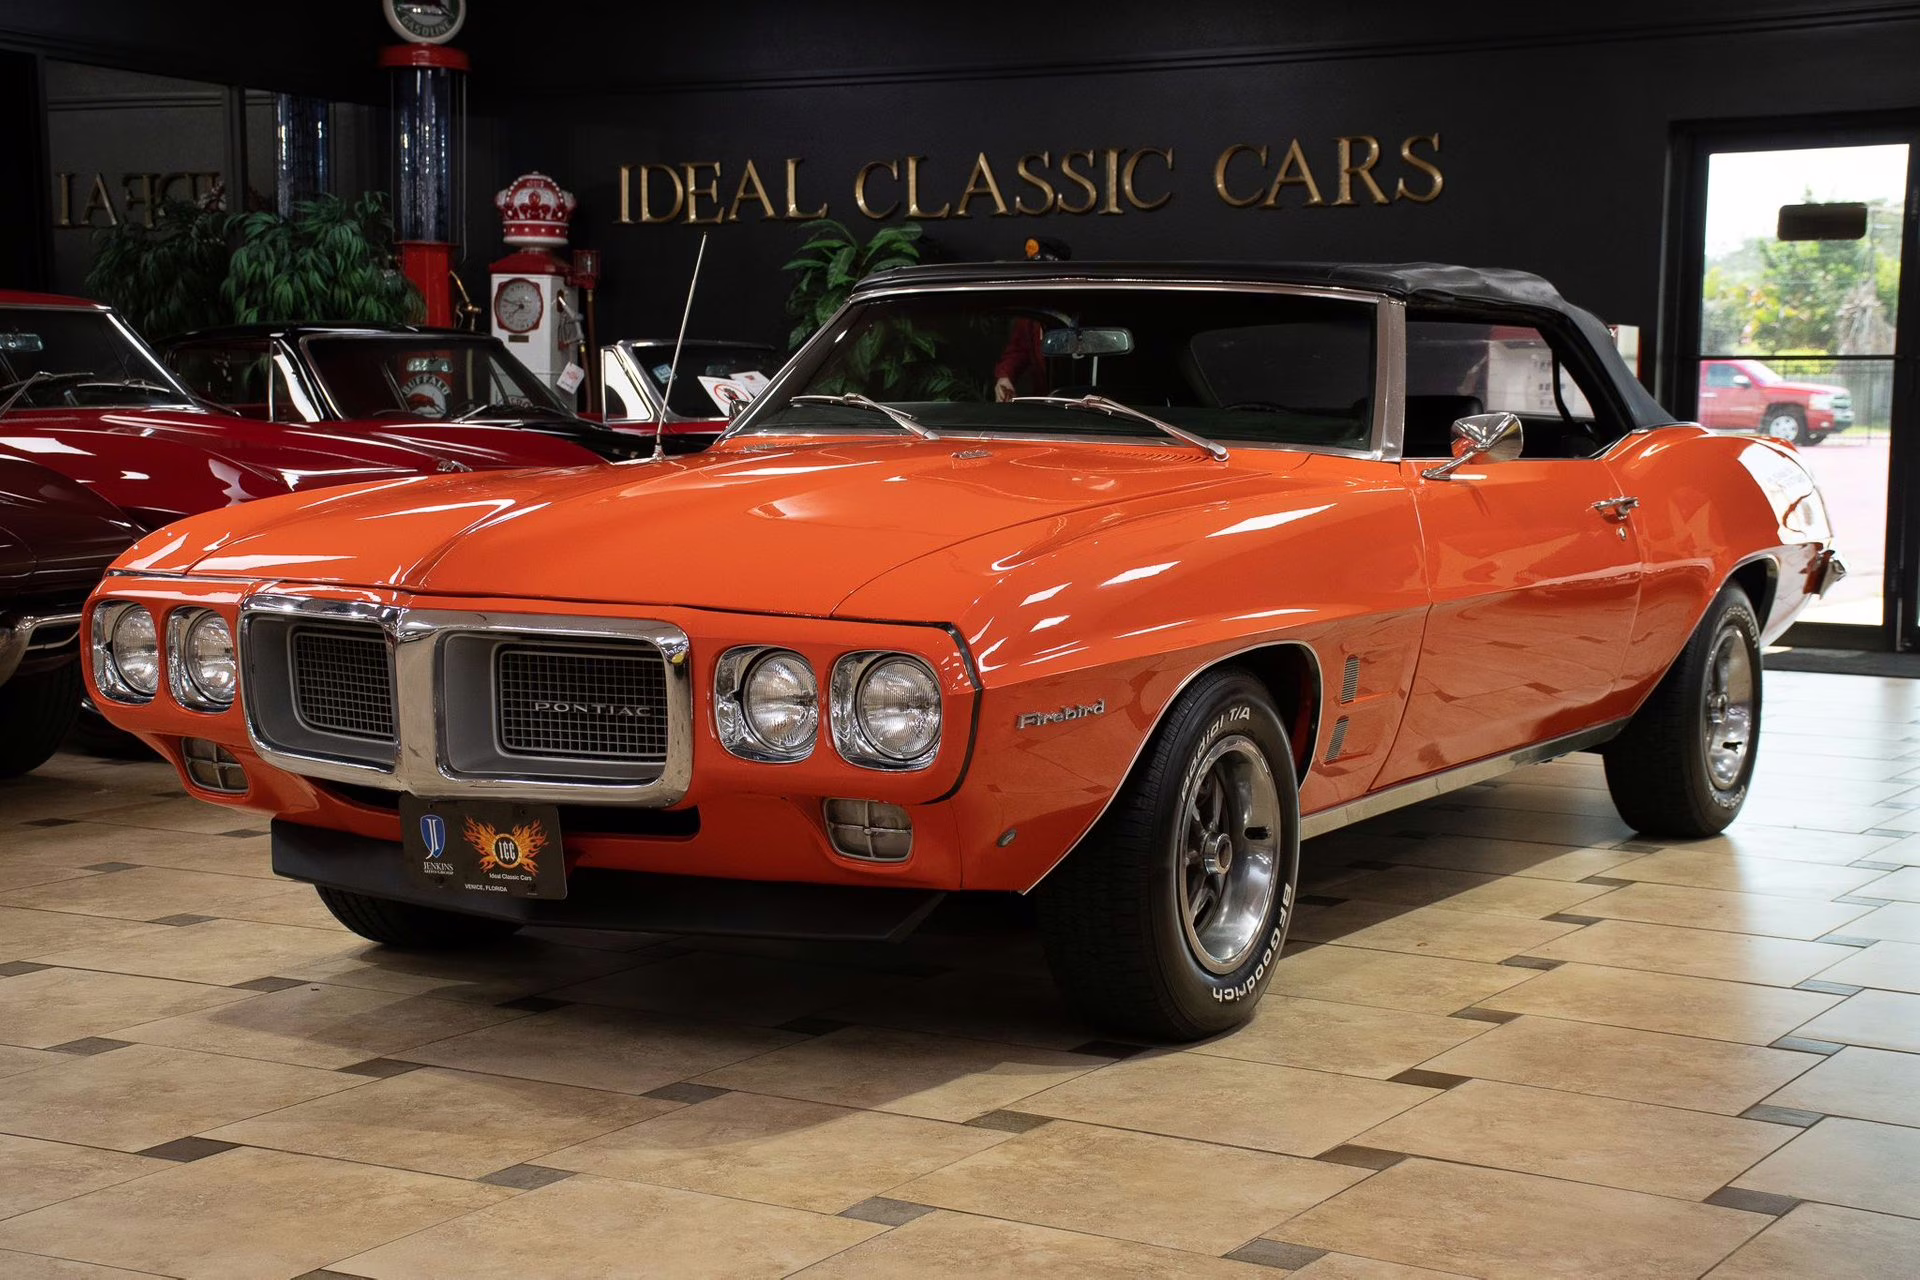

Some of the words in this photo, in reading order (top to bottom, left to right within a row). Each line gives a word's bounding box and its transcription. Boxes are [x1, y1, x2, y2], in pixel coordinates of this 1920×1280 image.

[401, 15, 452, 36] GASOLINE
[613, 157, 828, 224] IDEAL
[855, 148, 1173, 220] CLASSIC
[1214, 132, 1444, 208] CARS
[534, 702, 651, 717] PONTIAC
[1016, 697, 1105, 730] Firebird
[1229, 706, 1251, 722] T/A
[498, 841, 516, 861] ICC
[423, 861, 454, 871] JENKINS
[501, 873, 520, 881] Classic
[485, 884, 508, 892] FLORIDA
[1212, 882, 1292, 1003] BFGoodrich
